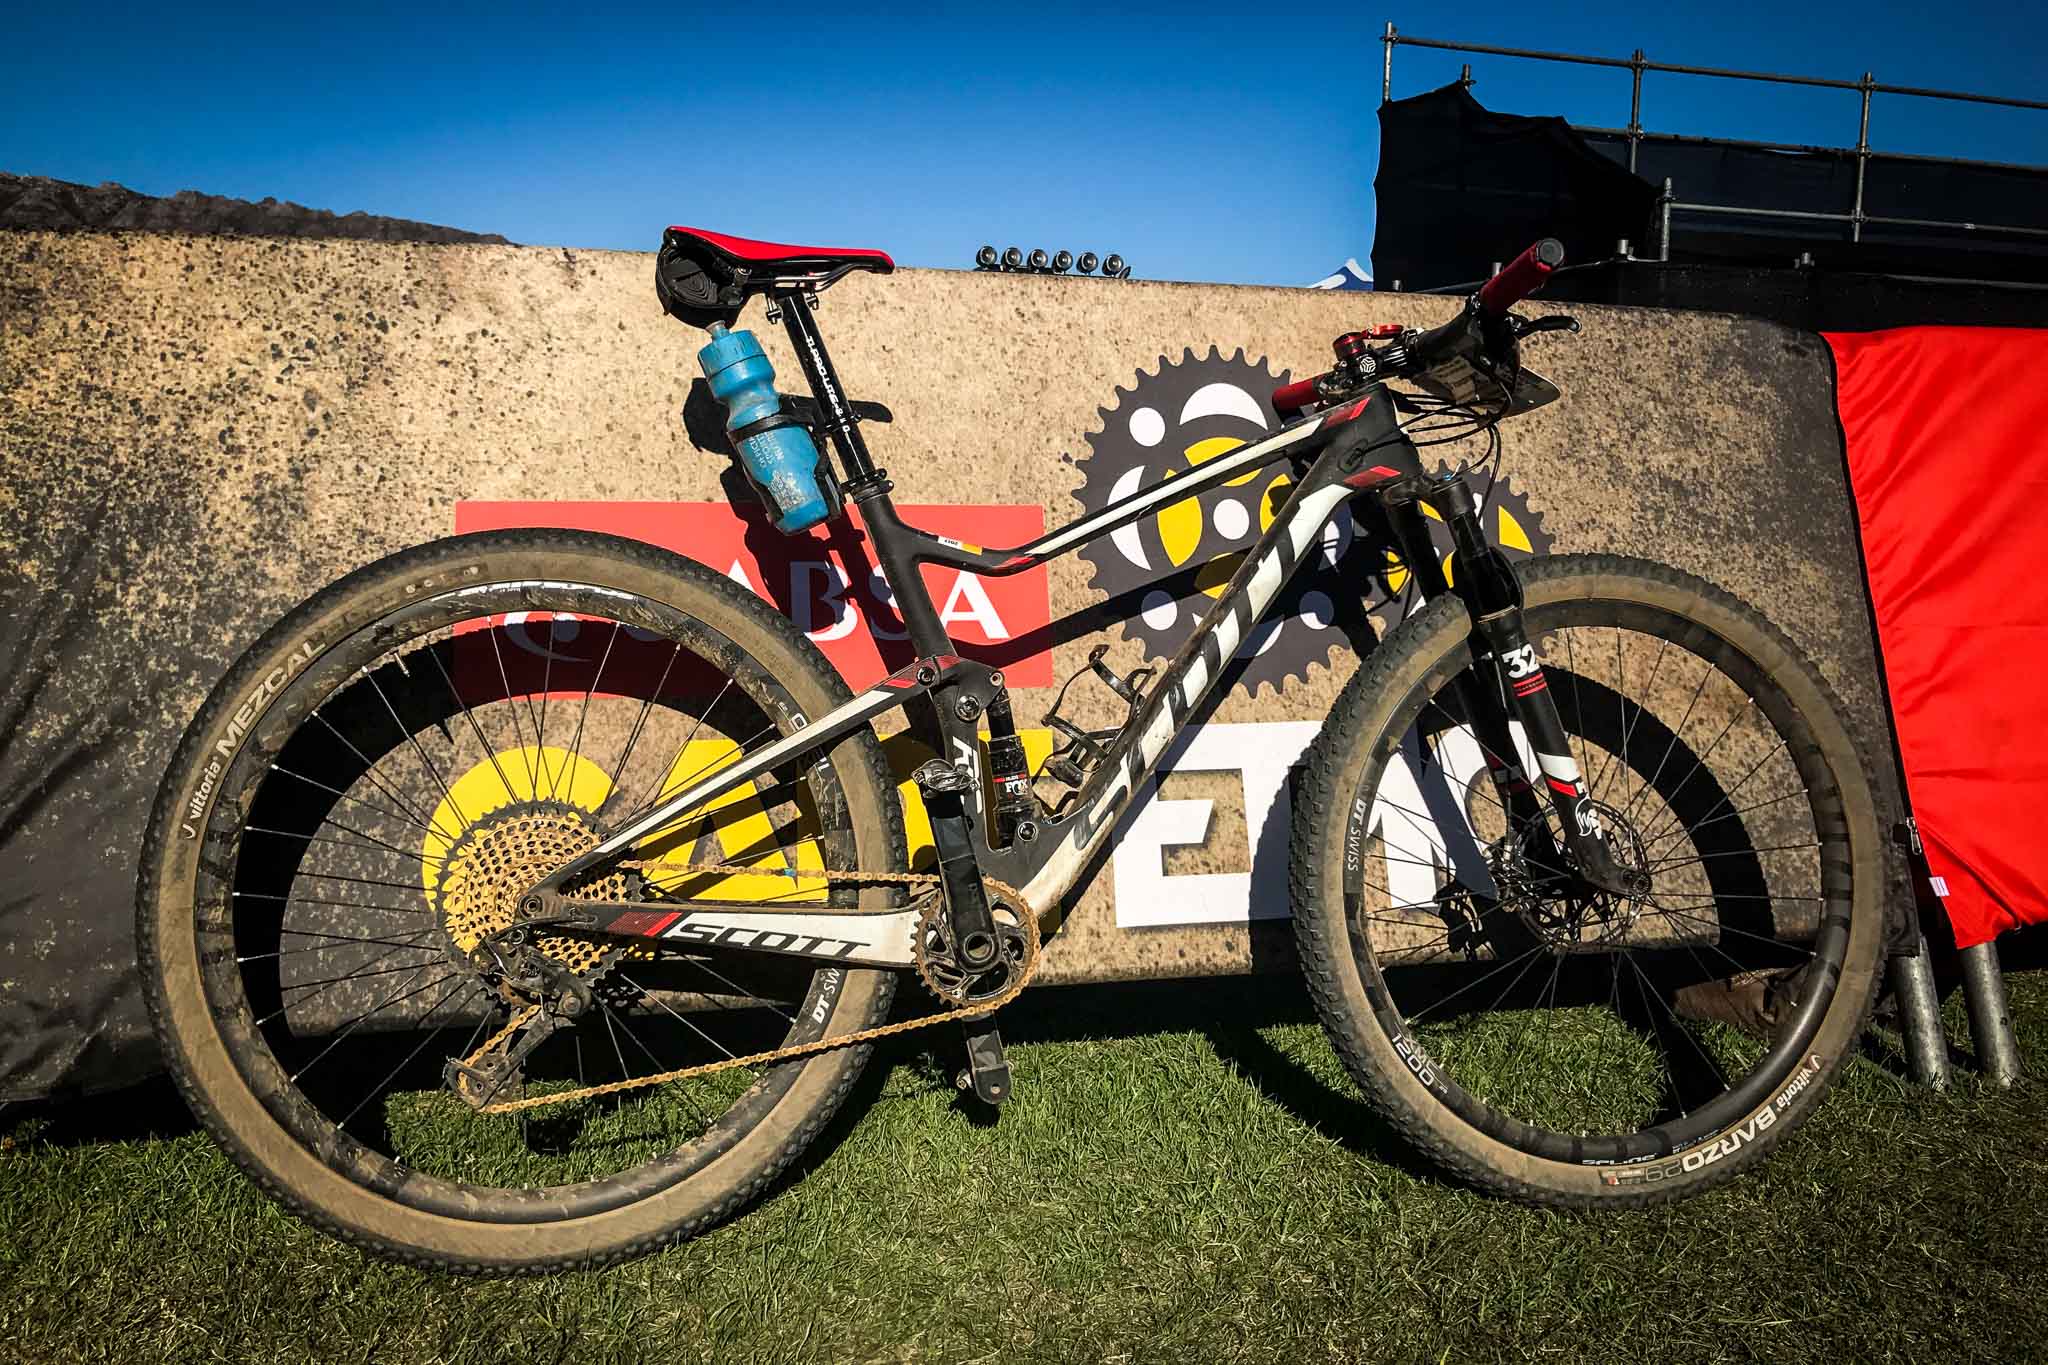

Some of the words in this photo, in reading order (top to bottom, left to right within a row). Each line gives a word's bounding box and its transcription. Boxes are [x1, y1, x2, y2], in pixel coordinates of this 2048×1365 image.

[726, 559, 1011, 640] BSA
[1501, 643, 1540, 679] 32
[190, 760, 222, 821] vittoria
[215, 641, 326, 758] MEZCAL
[1004, 780, 1029, 797] FOX
[1352, 798, 1368, 826] DT
[1347, 826, 1361, 872] SWISS
[668, 923, 872, 958] SCOTT
[811, 992, 832, 1025] DT
[1391, 1032, 1435, 1087] 1200
[1775, 1068, 1817, 1111] vittoria
[1682, 1105, 1777, 1173] BARZO
